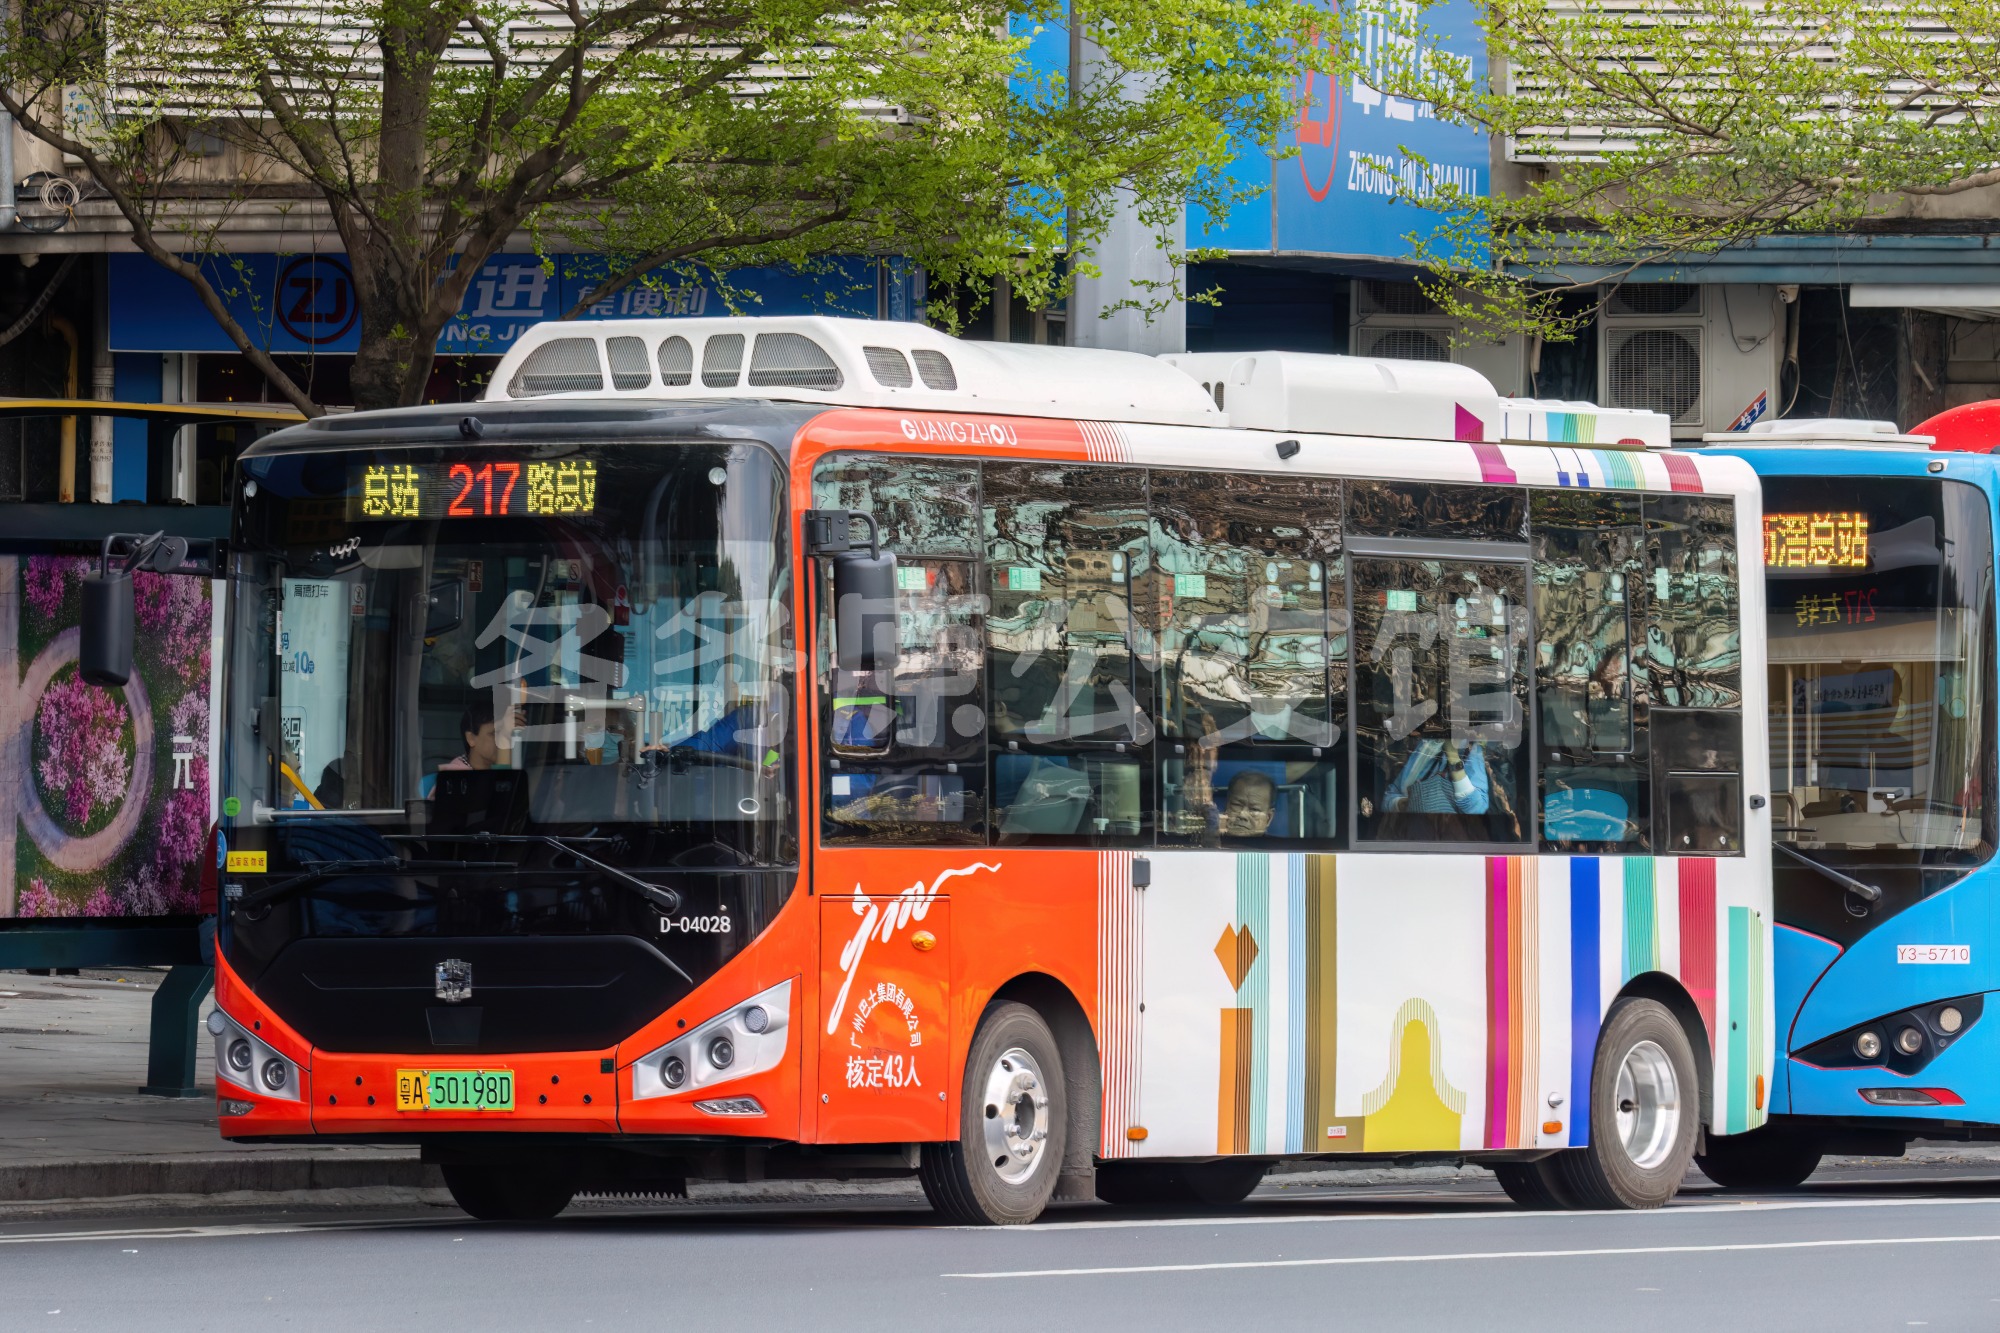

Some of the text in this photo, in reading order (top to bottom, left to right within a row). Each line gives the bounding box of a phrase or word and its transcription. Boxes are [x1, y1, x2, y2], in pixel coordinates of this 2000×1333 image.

[1347, 150, 1394, 196] ZHONG
[288, 277, 347, 324] ZJ
[900, 418, 1018, 446] GUANGZHOU
[363, 465, 419, 517] 总站
[448, 463, 521, 516] 217
[294, 584, 329, 598] 高德打车
[660, 916, 731, 933] D-04028
[1898, 947, 1969, 961] Y3-5710
[850, 982, 922, 1049] 广州巴士集团有限公司
[846, 1055, 922, 1088] 核定43人
